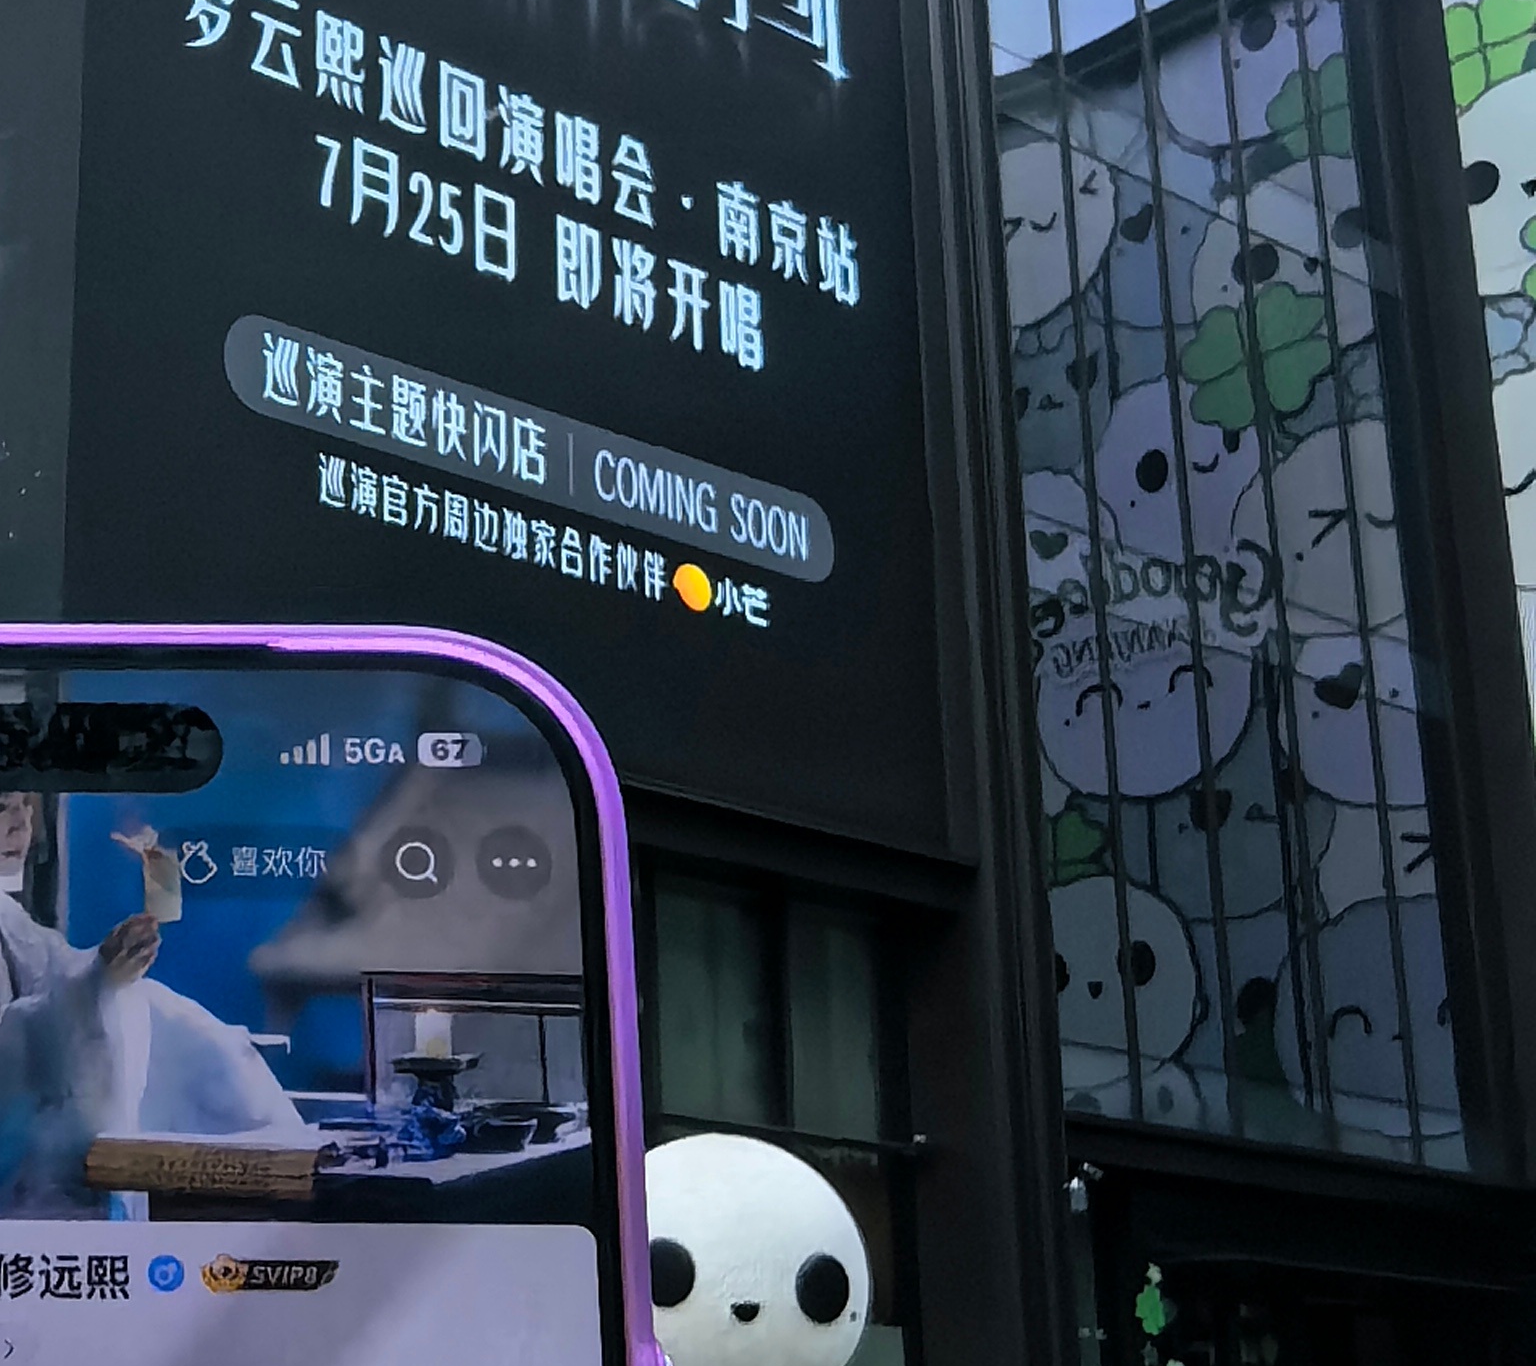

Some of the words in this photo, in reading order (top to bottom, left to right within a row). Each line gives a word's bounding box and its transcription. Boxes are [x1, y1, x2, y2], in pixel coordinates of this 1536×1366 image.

[315, 134, 518, 284] 7月25日
[555, 213, 765, 373] 即将开唱
[262, 332, 547, 486] 巡演主题快闪店
[594, 447, 718, 534] COMING
[729, 485, 810, 563] SOON
[317, 452, 668, 603] 巡演官方周边独家合作伙伴
[714, 576, 771, 628] 小芒
[343, 736, 406, 765] 5GA
[429, 739, 470, 762] 67
[231, 845, 326, 879] 喜欢你
